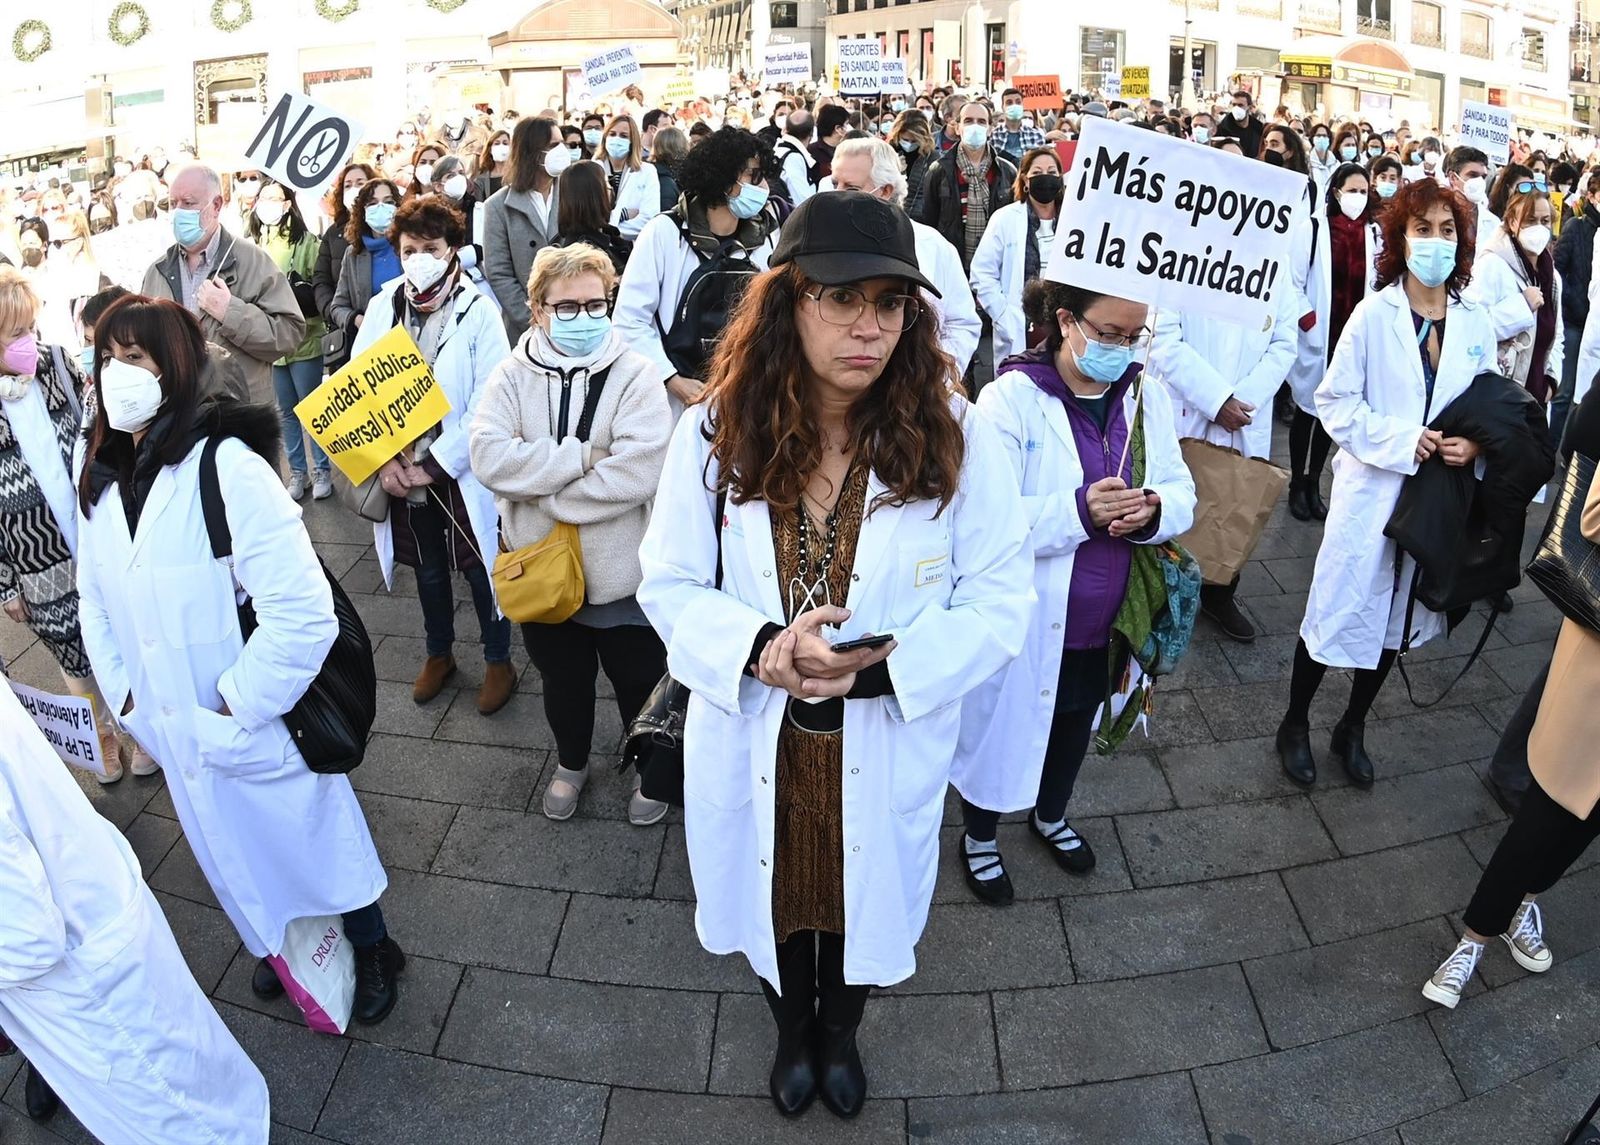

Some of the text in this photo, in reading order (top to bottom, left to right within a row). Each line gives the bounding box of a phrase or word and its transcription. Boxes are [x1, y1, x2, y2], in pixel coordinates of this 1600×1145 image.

[777, 53, 792, 62] Sanidad
[840, 44, 879, 56] RECORTES
[841, 60, 880, 72] EN SANIDAD
[245, 93, 350, 189] NO
[1461, 123, 1470, 135] DE
[1475, 126, 1489, 138] PARA
[1077, 146, 1292, 237] ¡Más apoyos
[1064, 222, 1279, 302] a la Sanidad!
[311, 352, 426, 436] sanidad: pública,
[326, 410, 384, 455] universal
[377, 409, 394, 437] y
[36, 699, 79, 730] Atención
[81, 707, 93, 731] la
[44, 727, 95, 761] EL PP nos
[312, 926, 338, 967] DRUNI
